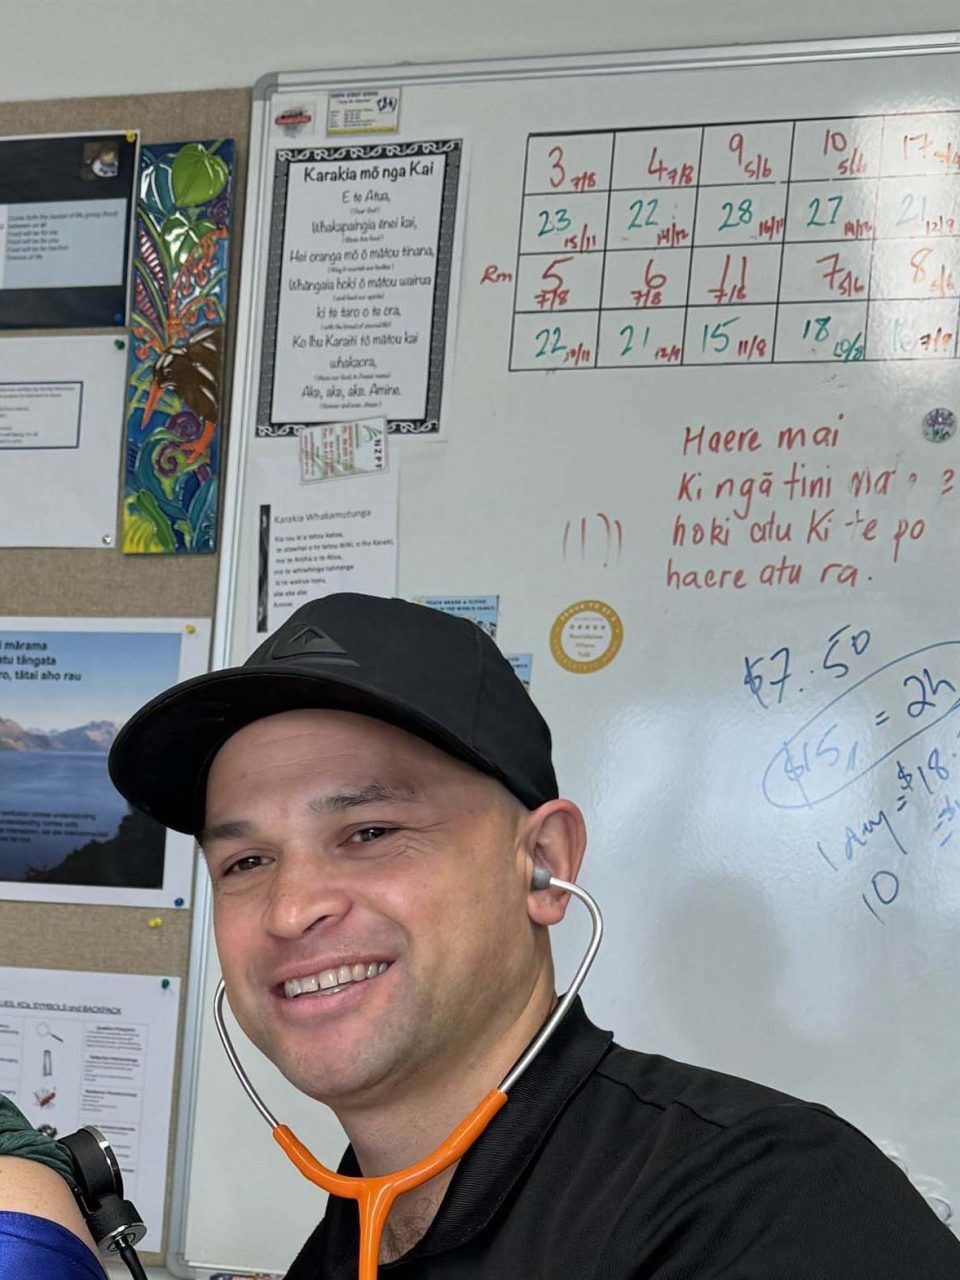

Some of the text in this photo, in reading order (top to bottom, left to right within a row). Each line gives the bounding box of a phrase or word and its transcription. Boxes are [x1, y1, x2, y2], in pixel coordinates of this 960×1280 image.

[729, 132, 772, 180] 9 5/6
[823, 129, 847, 155] 10
[304, 160, 434, 183] Karakia mō nga Kai
[548, 146, 566, 188] 3
[647, 146, 694, 186] 4 7/8
[342, 190, 350, 203] E
[807, 195, 844, 228] 27
[537, 208, 572, 237] 23
[628, 198, 658, 230] 22
[718, 198, 753, 232] 28
[480, 264, 512, 285] Rm
[542, 256, 574, 292] 5
[644, 259, 667, 290] 6
[816, 252, 845, 290] 7
[910, 247, 934, 284] 8
[535, 326, 567, 358] 22
[620, 325, 650, 356] 21
[701, 316, 740, 352] 15
[802, 316, 831, 342] 18
[683, 413, 844, 455] Haere mai
[678, 462, 832, 520] Ki ngā tini
[672, 515, 732, 546] hoki
[750, 512, 792, 544] atu
[844, 509, 877, 541] te
[893, 518, 924, 563] po
[667, 556, 873, 590] haere atu ra.
[4, 640, 48, 652] mārama
[41, 670, 61, 681] aho
[63, 672, 82, 682] rau
